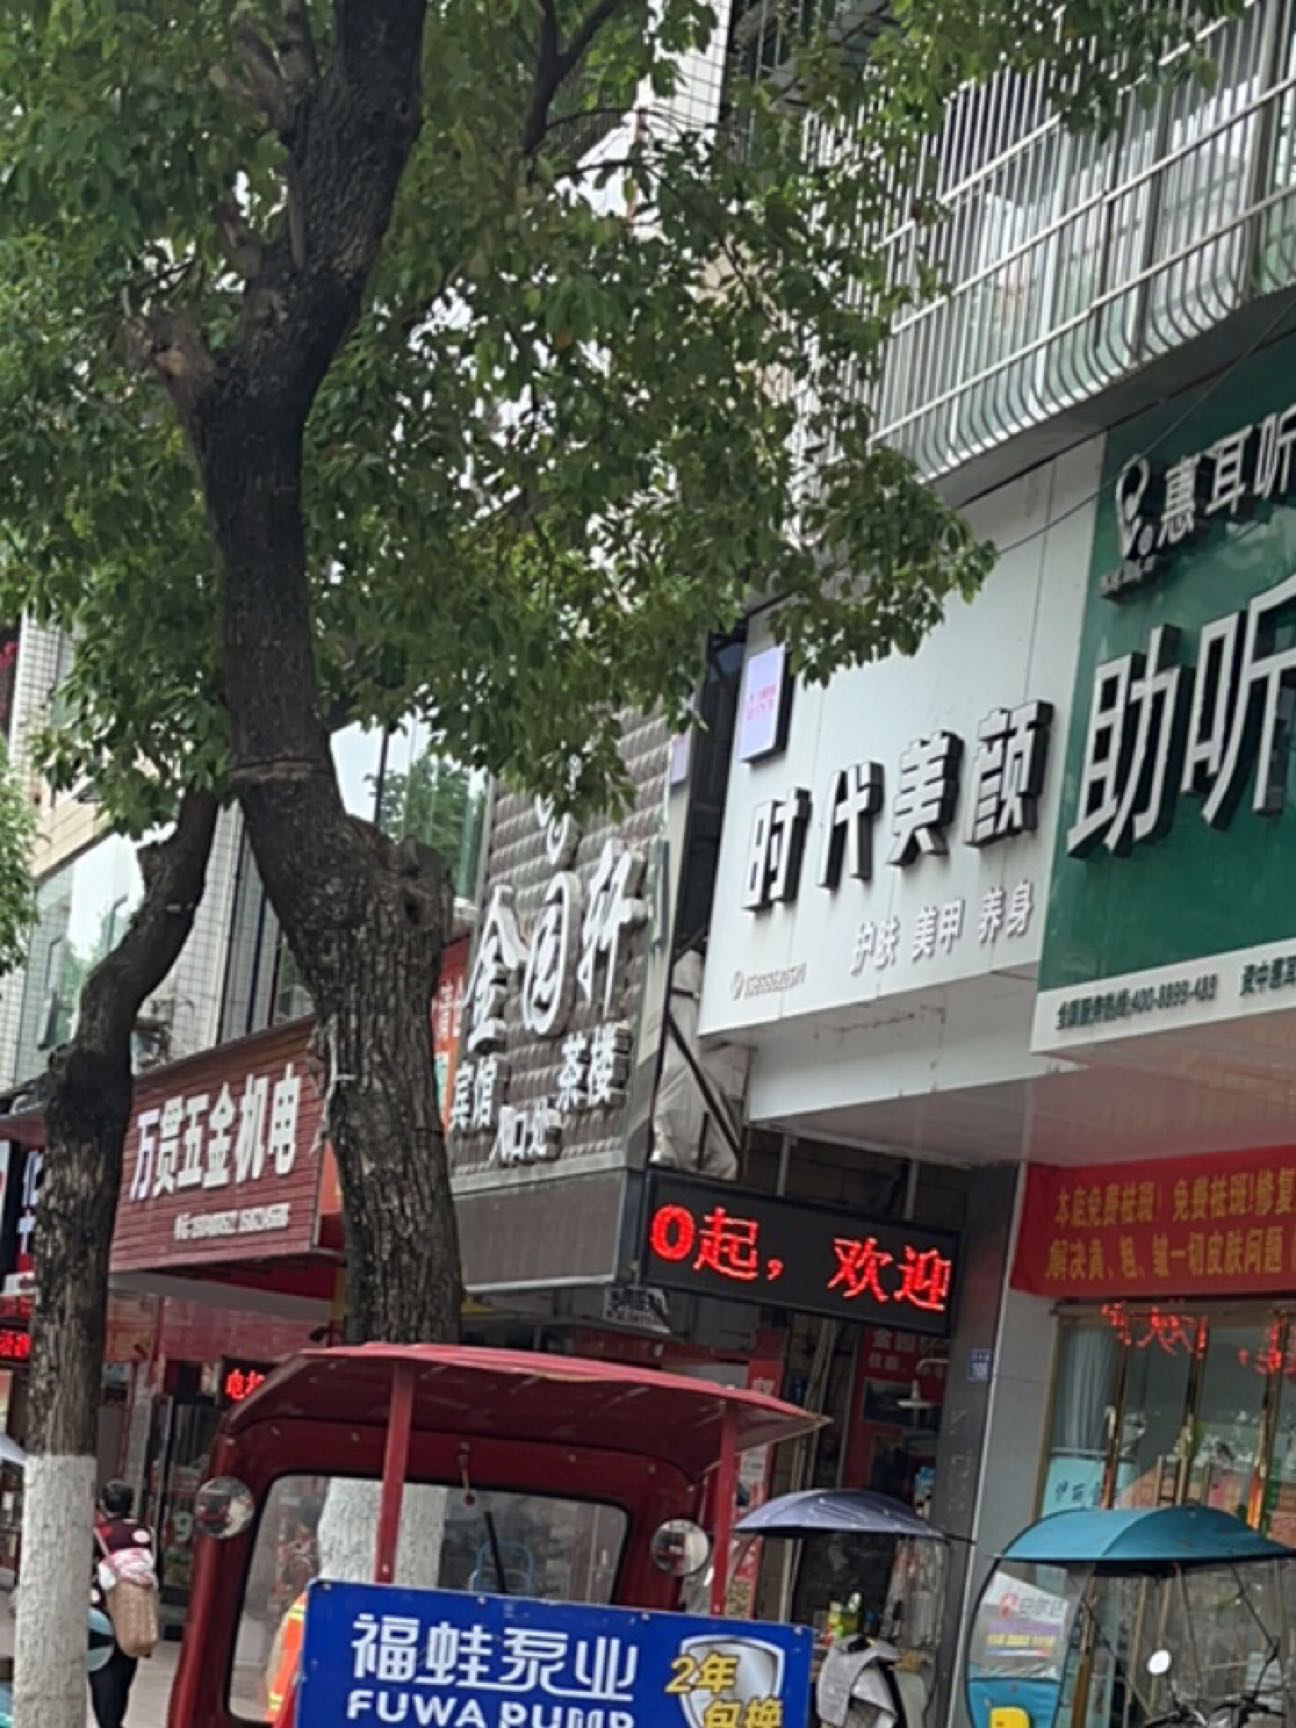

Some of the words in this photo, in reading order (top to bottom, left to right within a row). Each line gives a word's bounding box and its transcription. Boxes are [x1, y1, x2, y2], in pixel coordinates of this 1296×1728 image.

[744, 702, 1050, 912] 时代美颜
[912, 899, 963, 963] 美甲
[978, 880, 1033, 945] 养身
[827, 1237, 952, 1312] 欢迎
[351, 1613, 639, 1702] 福蛙泵业
[665, 1655, 740, 1694] 2年
